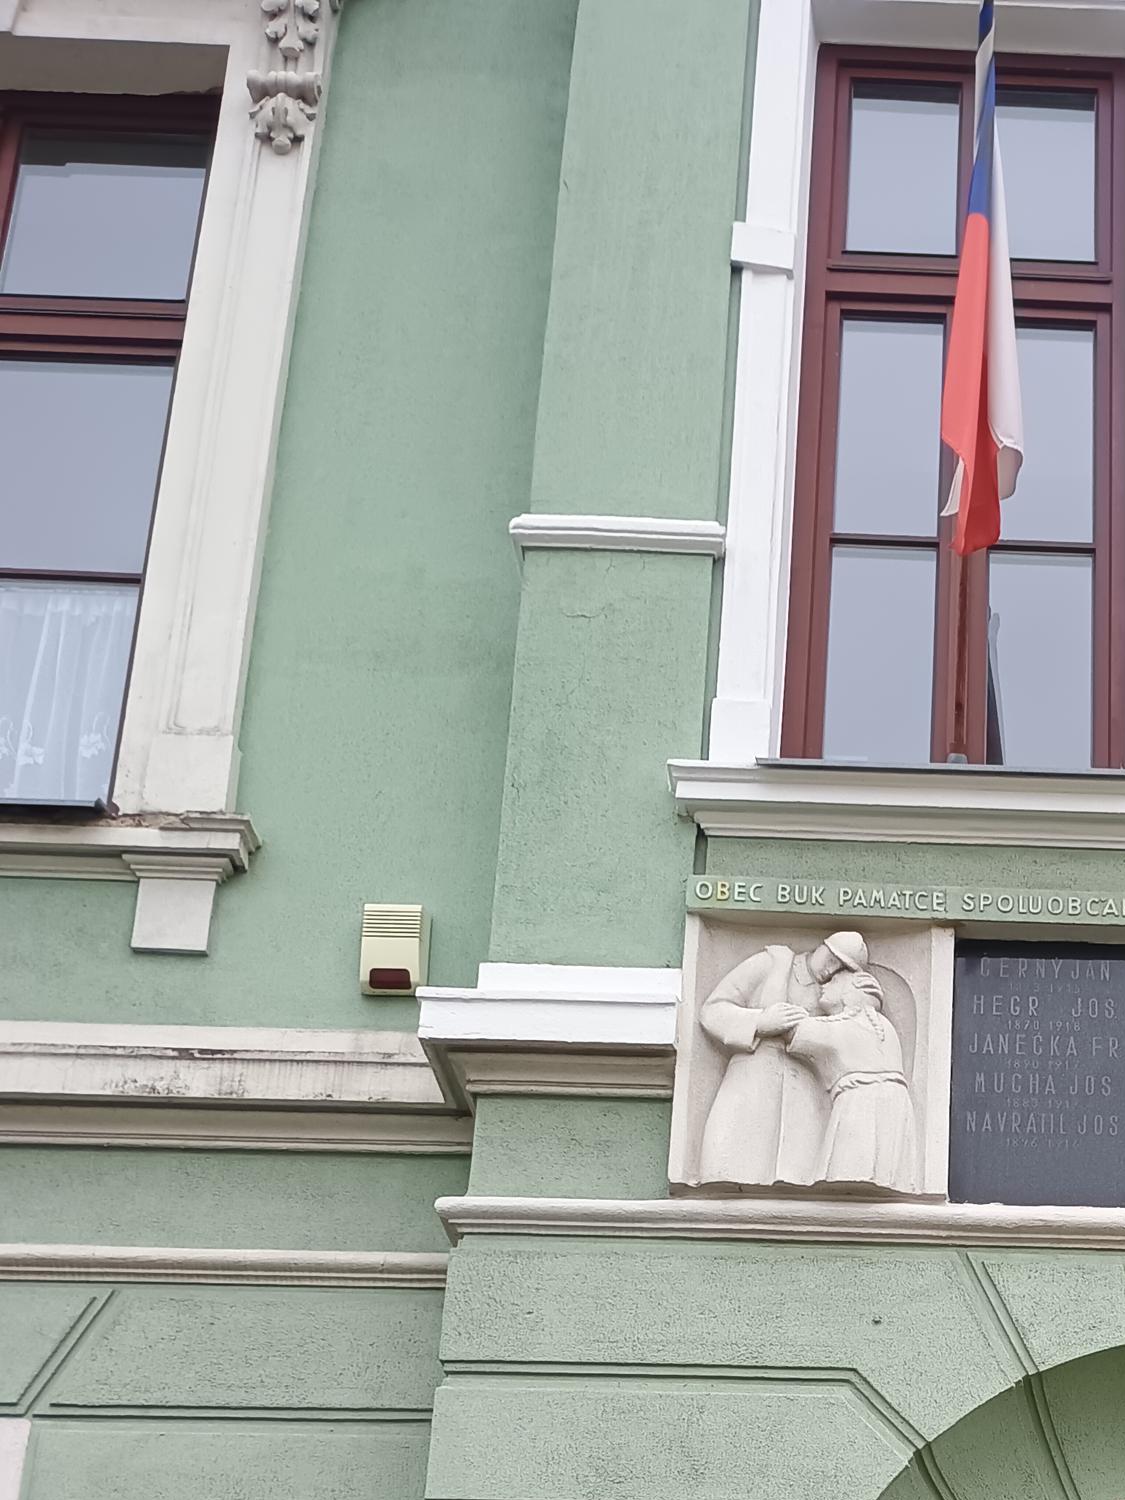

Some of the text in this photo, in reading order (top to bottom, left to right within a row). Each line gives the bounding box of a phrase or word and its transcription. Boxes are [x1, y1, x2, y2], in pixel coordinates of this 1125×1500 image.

[695, 881, 763, 902] OBEC
[777, 884, 825, 906] BUK
[973, 994, 1039, 1016] HEGR
[1092, 1036, 1119, 1057] FR
[975, 1072, 1111, 1096] MUCHA JOS
[1078, 1114, 1118, 1135] JOS
